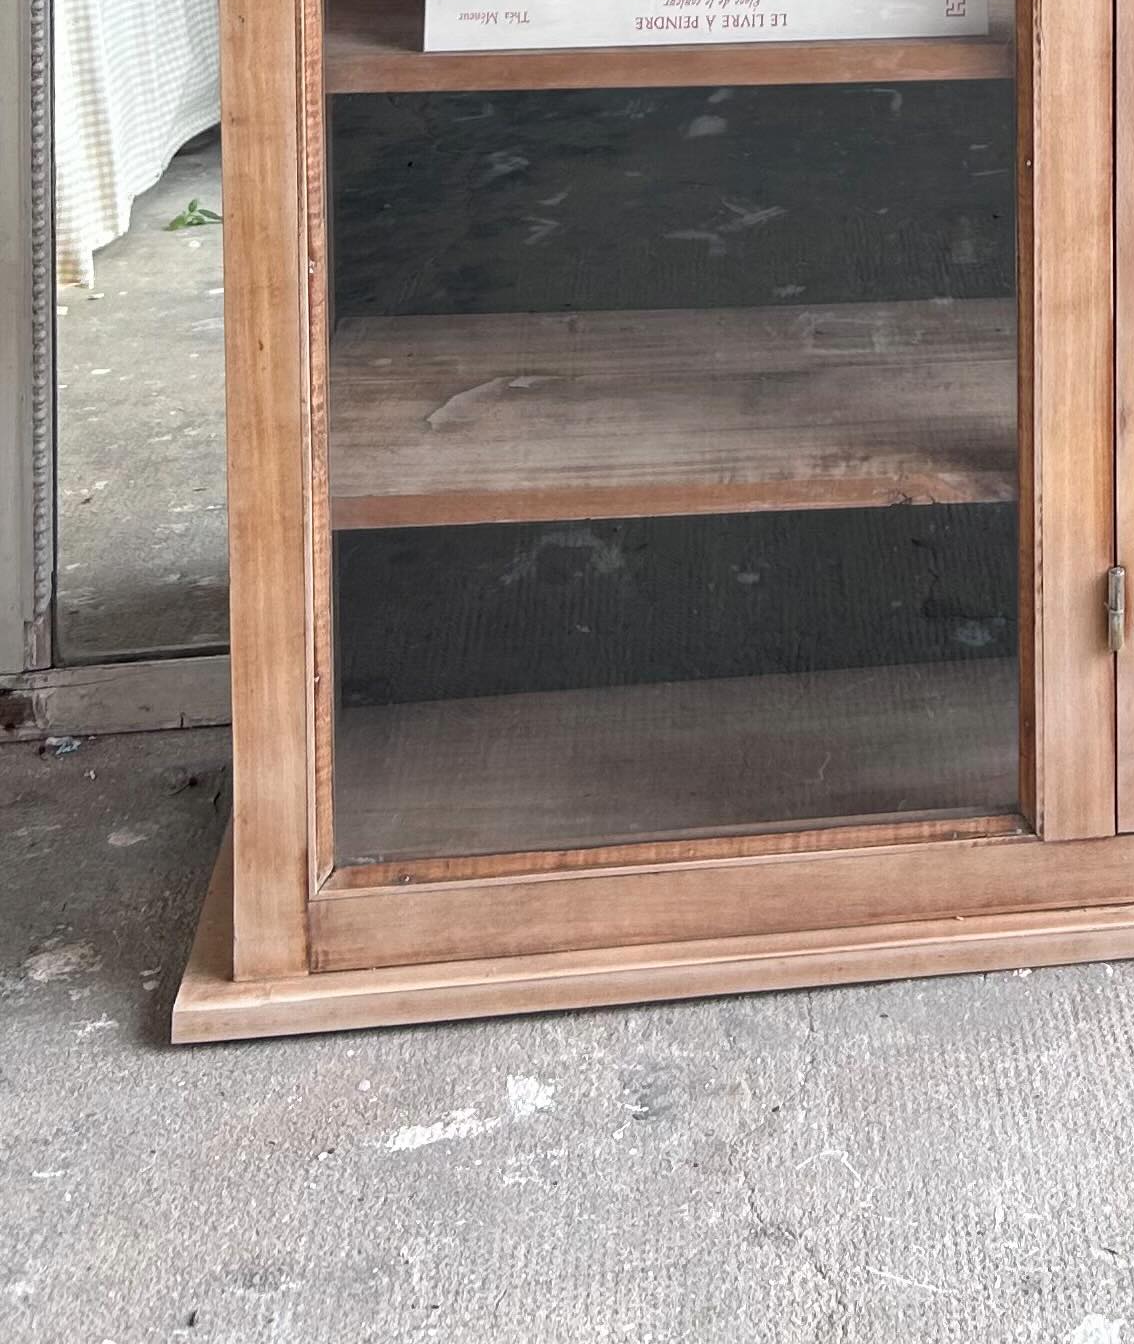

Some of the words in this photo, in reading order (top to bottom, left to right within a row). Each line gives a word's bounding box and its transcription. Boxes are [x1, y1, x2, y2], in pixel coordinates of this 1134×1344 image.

[635, 15, 699, 30] PEINDRE
[722, 14, 764, 28] LIVRE
[770, 13, 787, 27] LE
